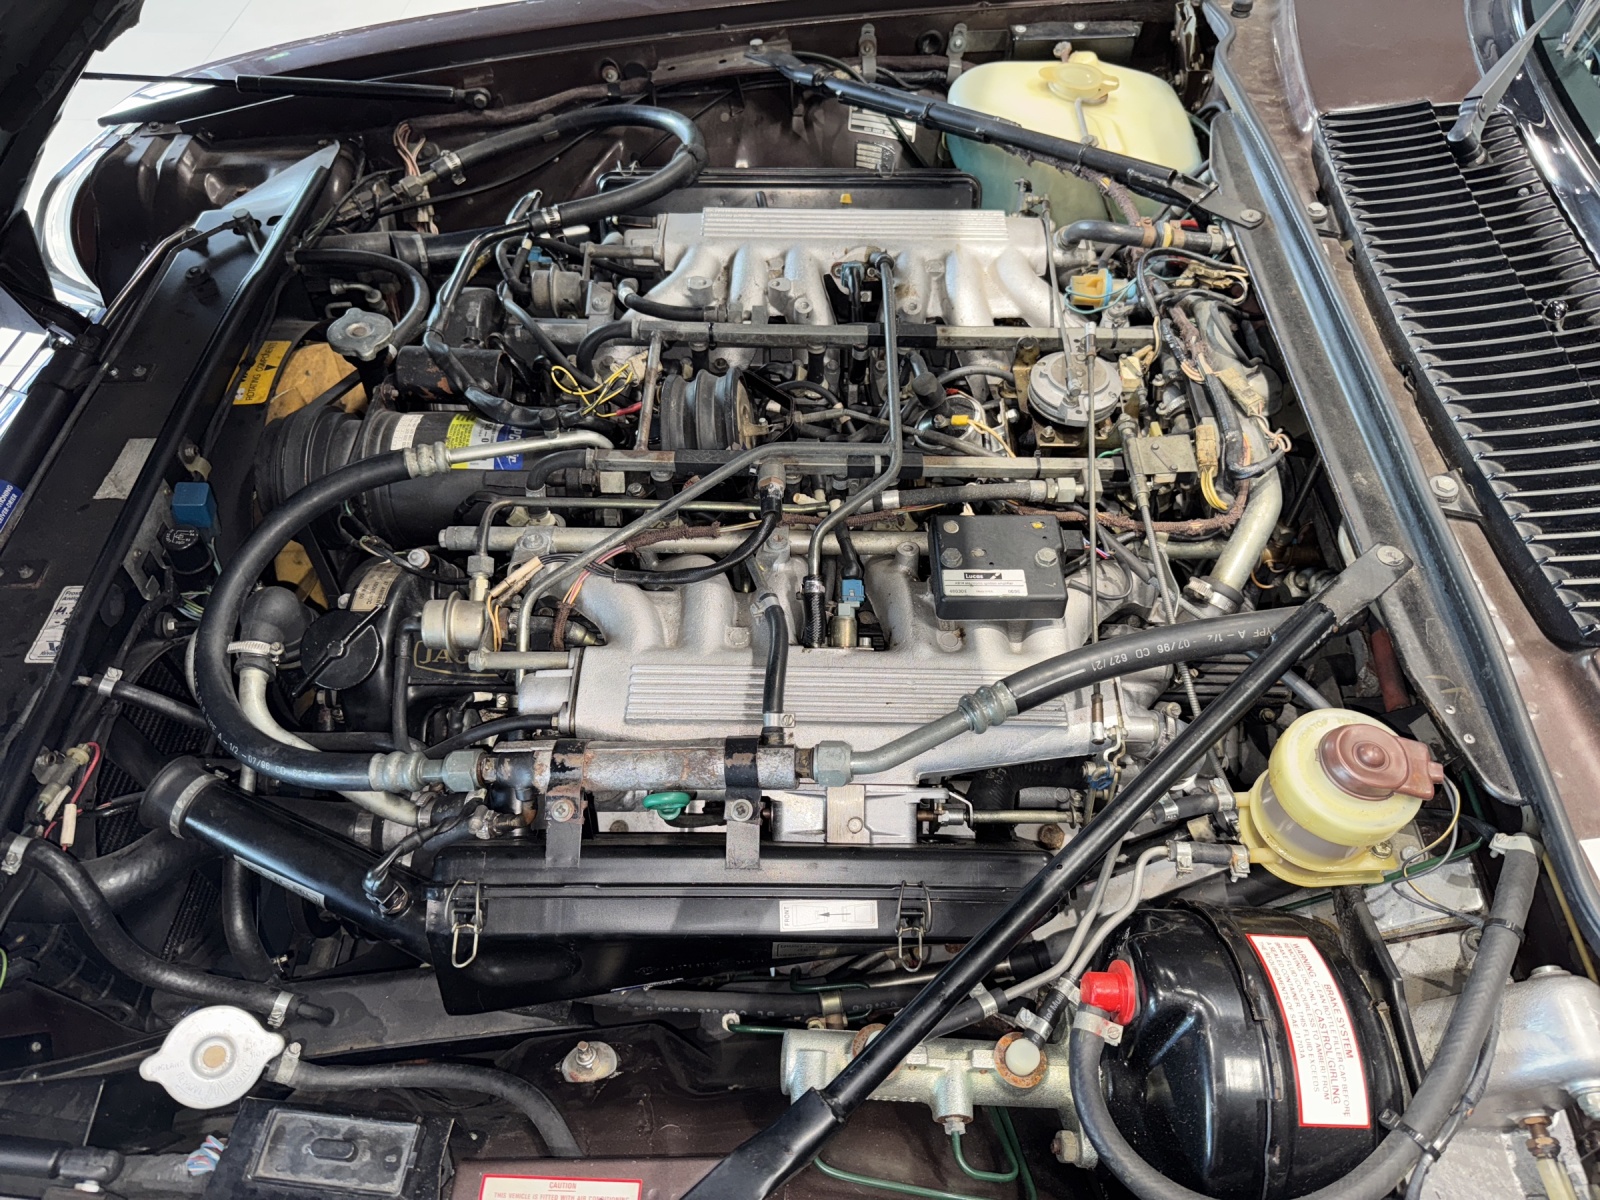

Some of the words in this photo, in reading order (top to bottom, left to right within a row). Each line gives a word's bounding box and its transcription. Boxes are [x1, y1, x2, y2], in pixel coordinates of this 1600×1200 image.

[245, 374, 261, 401] ROTATING
[1156, 639, 1190, 653] 07/96
[1238, 630, 1246, 639] A
[1091, 653, 1128, 671] 627/21
[1135, 647, 1150, 659] CD
[229, 743, 239, 755] 1/2
[248, 755, 271, 771] 07/96
[275, 765, 286, 775] CD
[1274, 942, 1289, 960] BRAKE
[1286, 960, 1297, 978] FLUID
[1265, 952, 1290, 1000] REQUIREMENTS
[1286, 1001, 1293, 1012] OF
[1290, 1014, 1298, 1029] SAE
[1294, 978, 1316, 1028] (COLOURLESS
[1313, 980, 1327, 1003] CLEAN
[1269, 946, 1284, 968] SEALED
[1298, 1011, 1307, 1028] THIS
[1303, 1029, 1313, 1051] FLUID
[1308, 1053, 1320, 1093] EXCEEDS
[1323, 1005, 1336, 1034] BOTTLE
[1324, 984, 1341, 1014] BRAKE
[1336, 1017, 1354, 1059] SYSTEM
[1301, 974, 1310, 986] USE
[1307, 988, 1319, 1006] ONLY
[1315, 1008, 1341, 1104] CASTROL/GIRLING
[1312, 1030, 1320, 1041] TO
[1315, 1043, 1326, 1074] AMBER)
[1332, 1036, 1343, 1062] FILLER
[1338, 1064, 1347, 1082] CAP
[1322, 1075, 1330, 1101] FROM
[1342, 1084, 1351, 1117] BEFORE
[509, 1192, 531, 1200] VEHICLE
[549, 1181, 577, 1189] CAUTION
